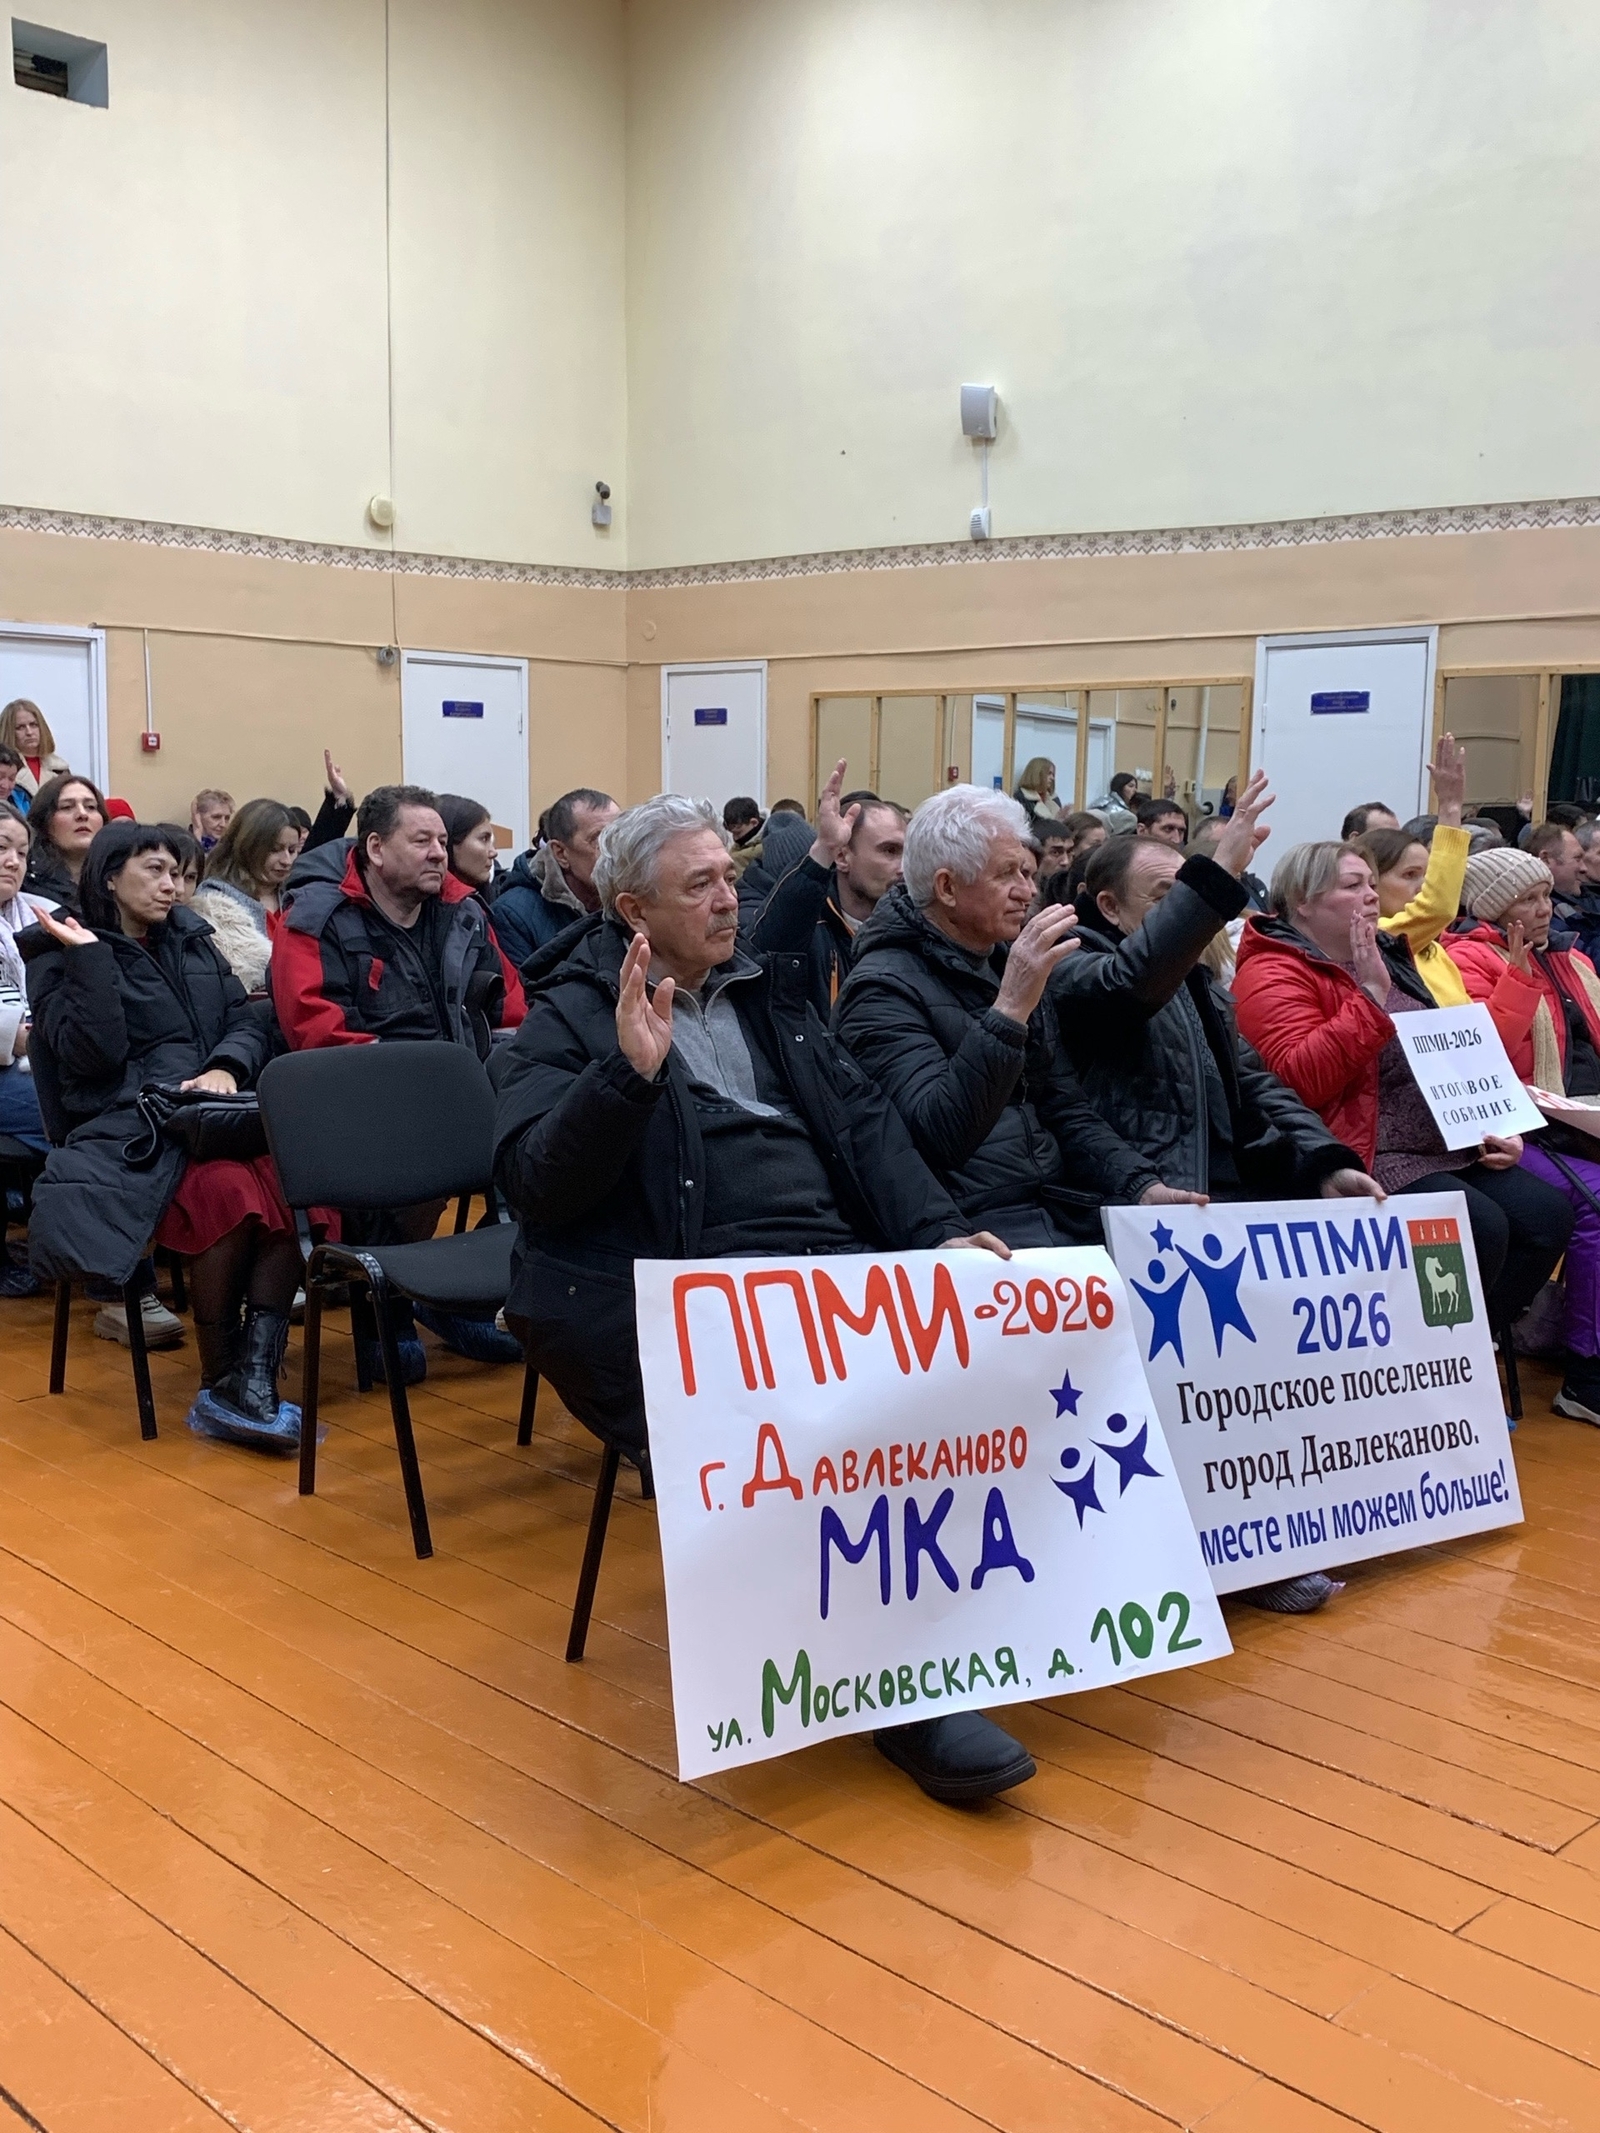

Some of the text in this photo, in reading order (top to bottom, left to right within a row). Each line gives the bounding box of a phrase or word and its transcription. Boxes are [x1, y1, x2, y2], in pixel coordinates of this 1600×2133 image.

[1412, 1027, 1482, 1054] ППМИ-2026
[1429, 1074, 1503, 1101] ИТОГОВОЕ
[1245, 1216, 1408, 1281] ППМИ
[672, 1263, 1114, 1396] ППМИ-2026
[1292, 1292, 1391, 1355] 2026
[1176, 1356, 1473, 1432] Городское поселение
[700, 1461, 726, 1511] г.
[1203, 1418, 1480, 1501] город Давлеканово.
[1199, 1458, 1510, 1568] месте мы можем больше!
[820, 1487, 1036, 1620] МКД
[1090, 1591, 1202, 1666] 102
